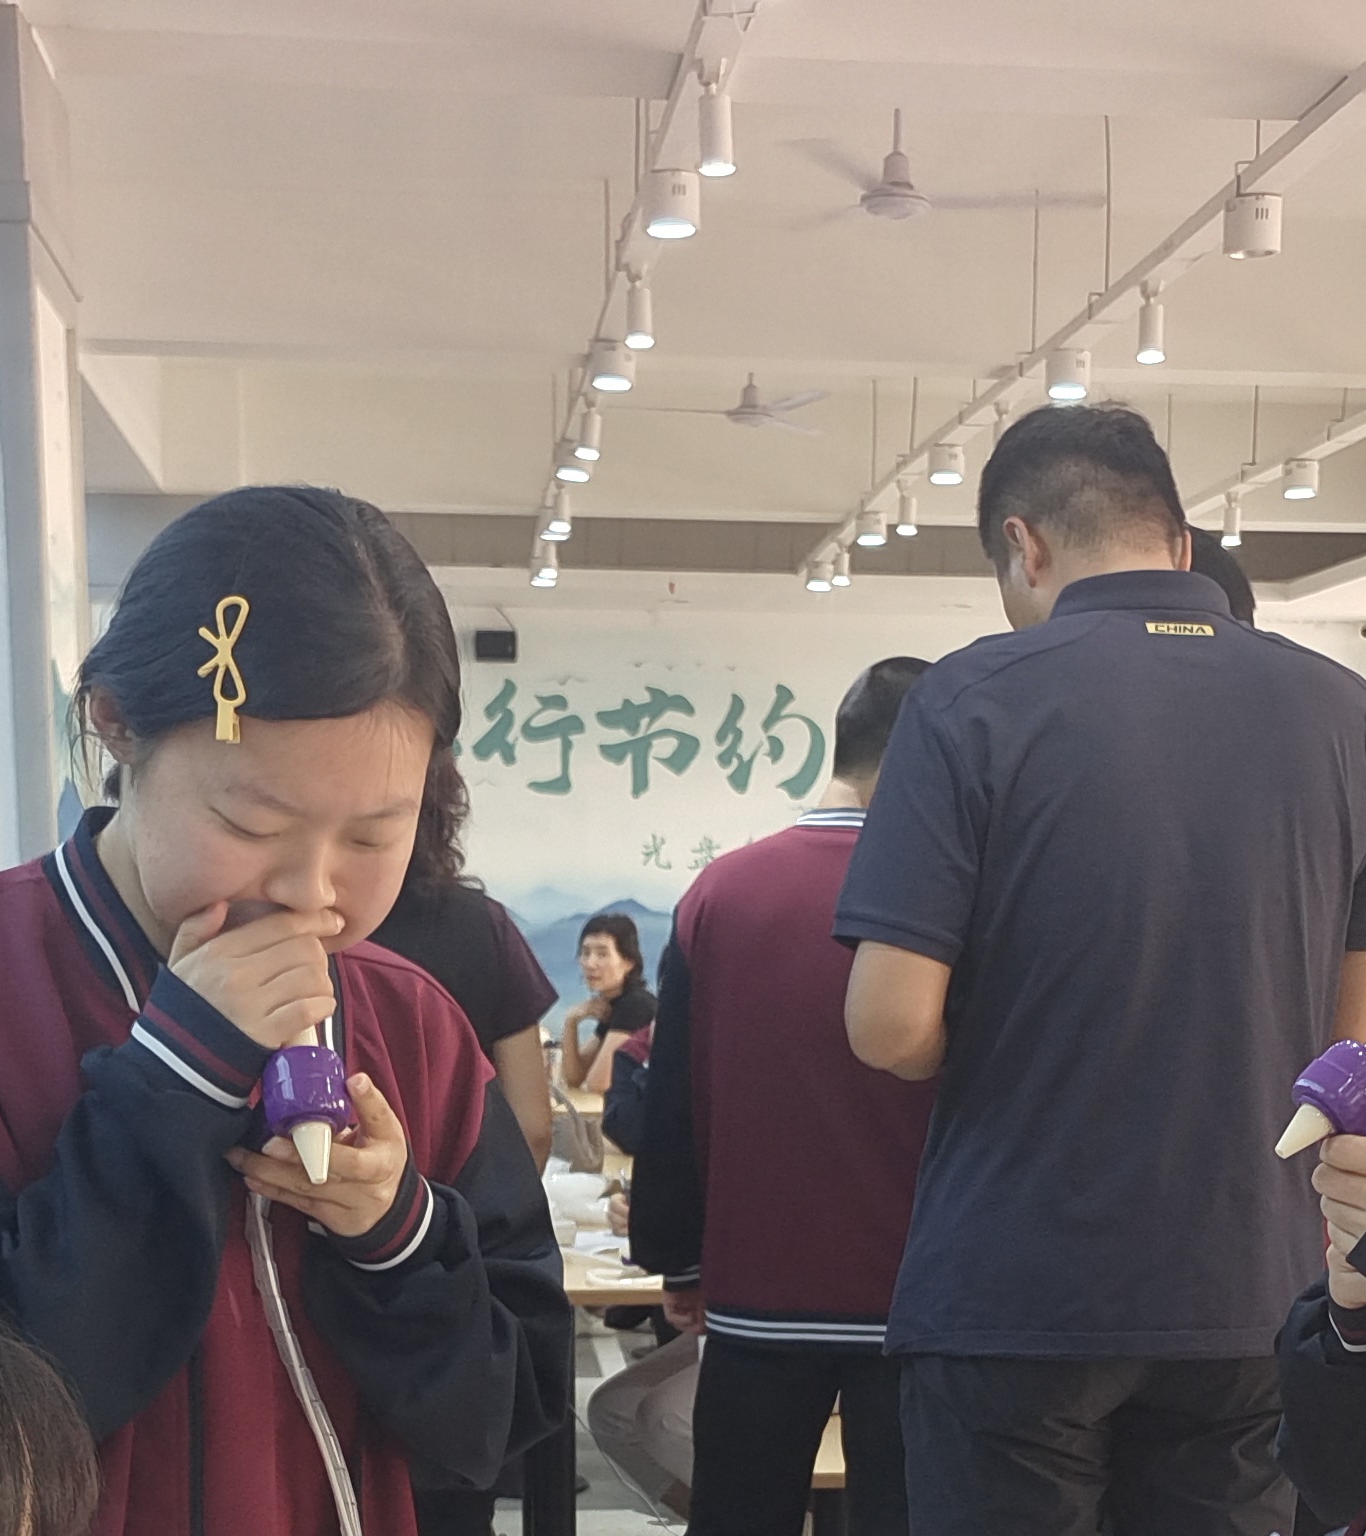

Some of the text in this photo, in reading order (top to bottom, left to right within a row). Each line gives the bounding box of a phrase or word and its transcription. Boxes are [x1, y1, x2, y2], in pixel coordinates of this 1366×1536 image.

[1154, 624, 1208, 635] CHINA
[453, 678, 827, 800] 行节约
